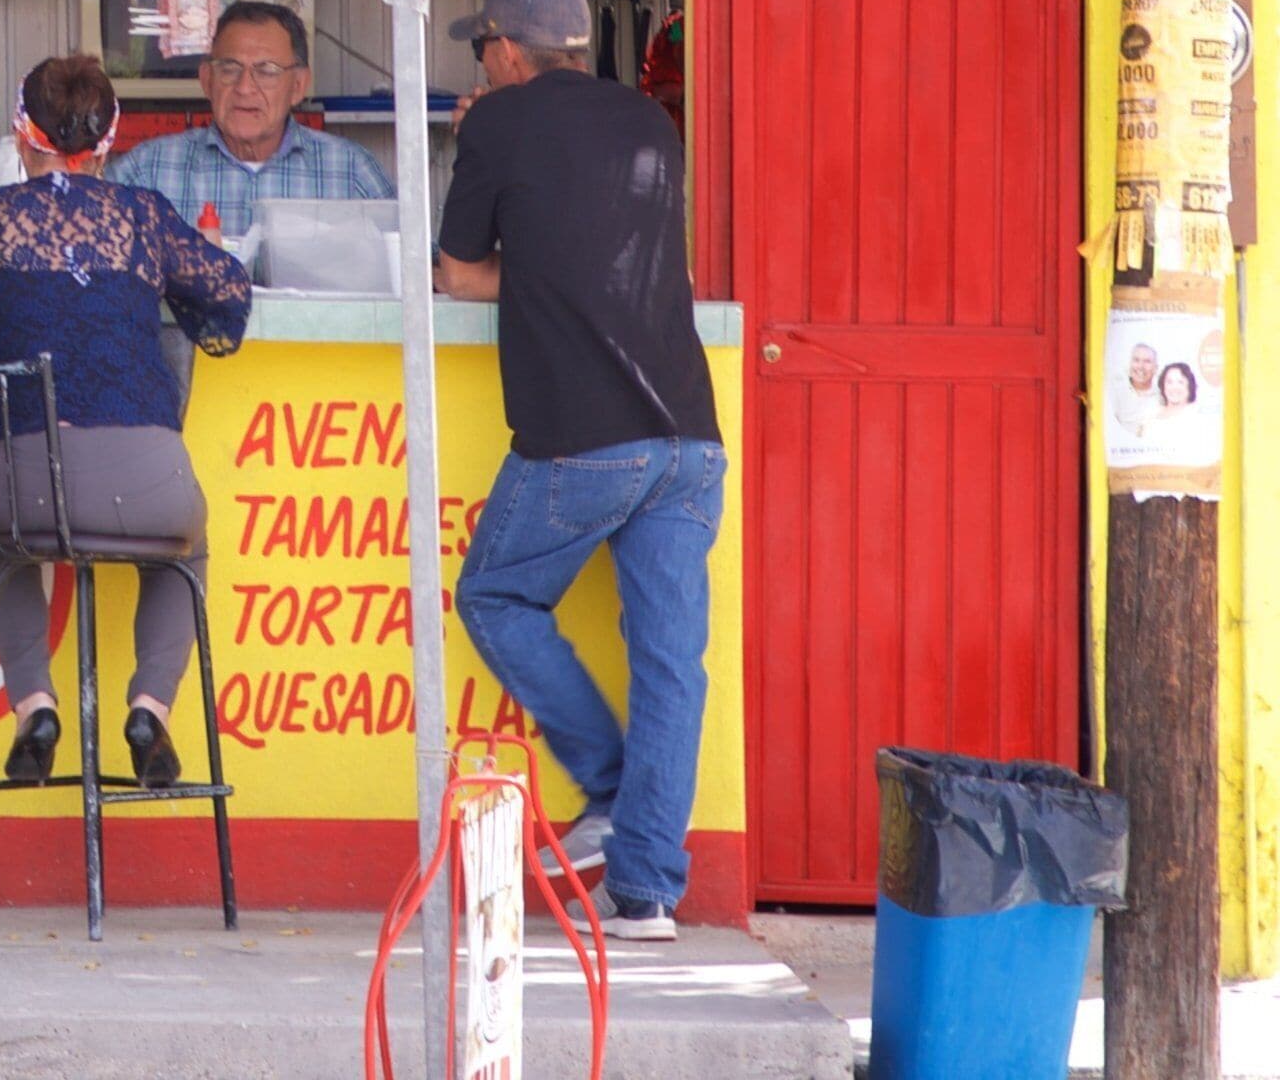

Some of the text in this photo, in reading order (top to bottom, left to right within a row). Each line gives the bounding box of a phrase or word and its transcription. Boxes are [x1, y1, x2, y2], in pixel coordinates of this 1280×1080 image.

[235, 401, 409, 469] AVEN
[232, 584, 453, 647] TORTA
[216, 670, 544, 750] QUESADLA
